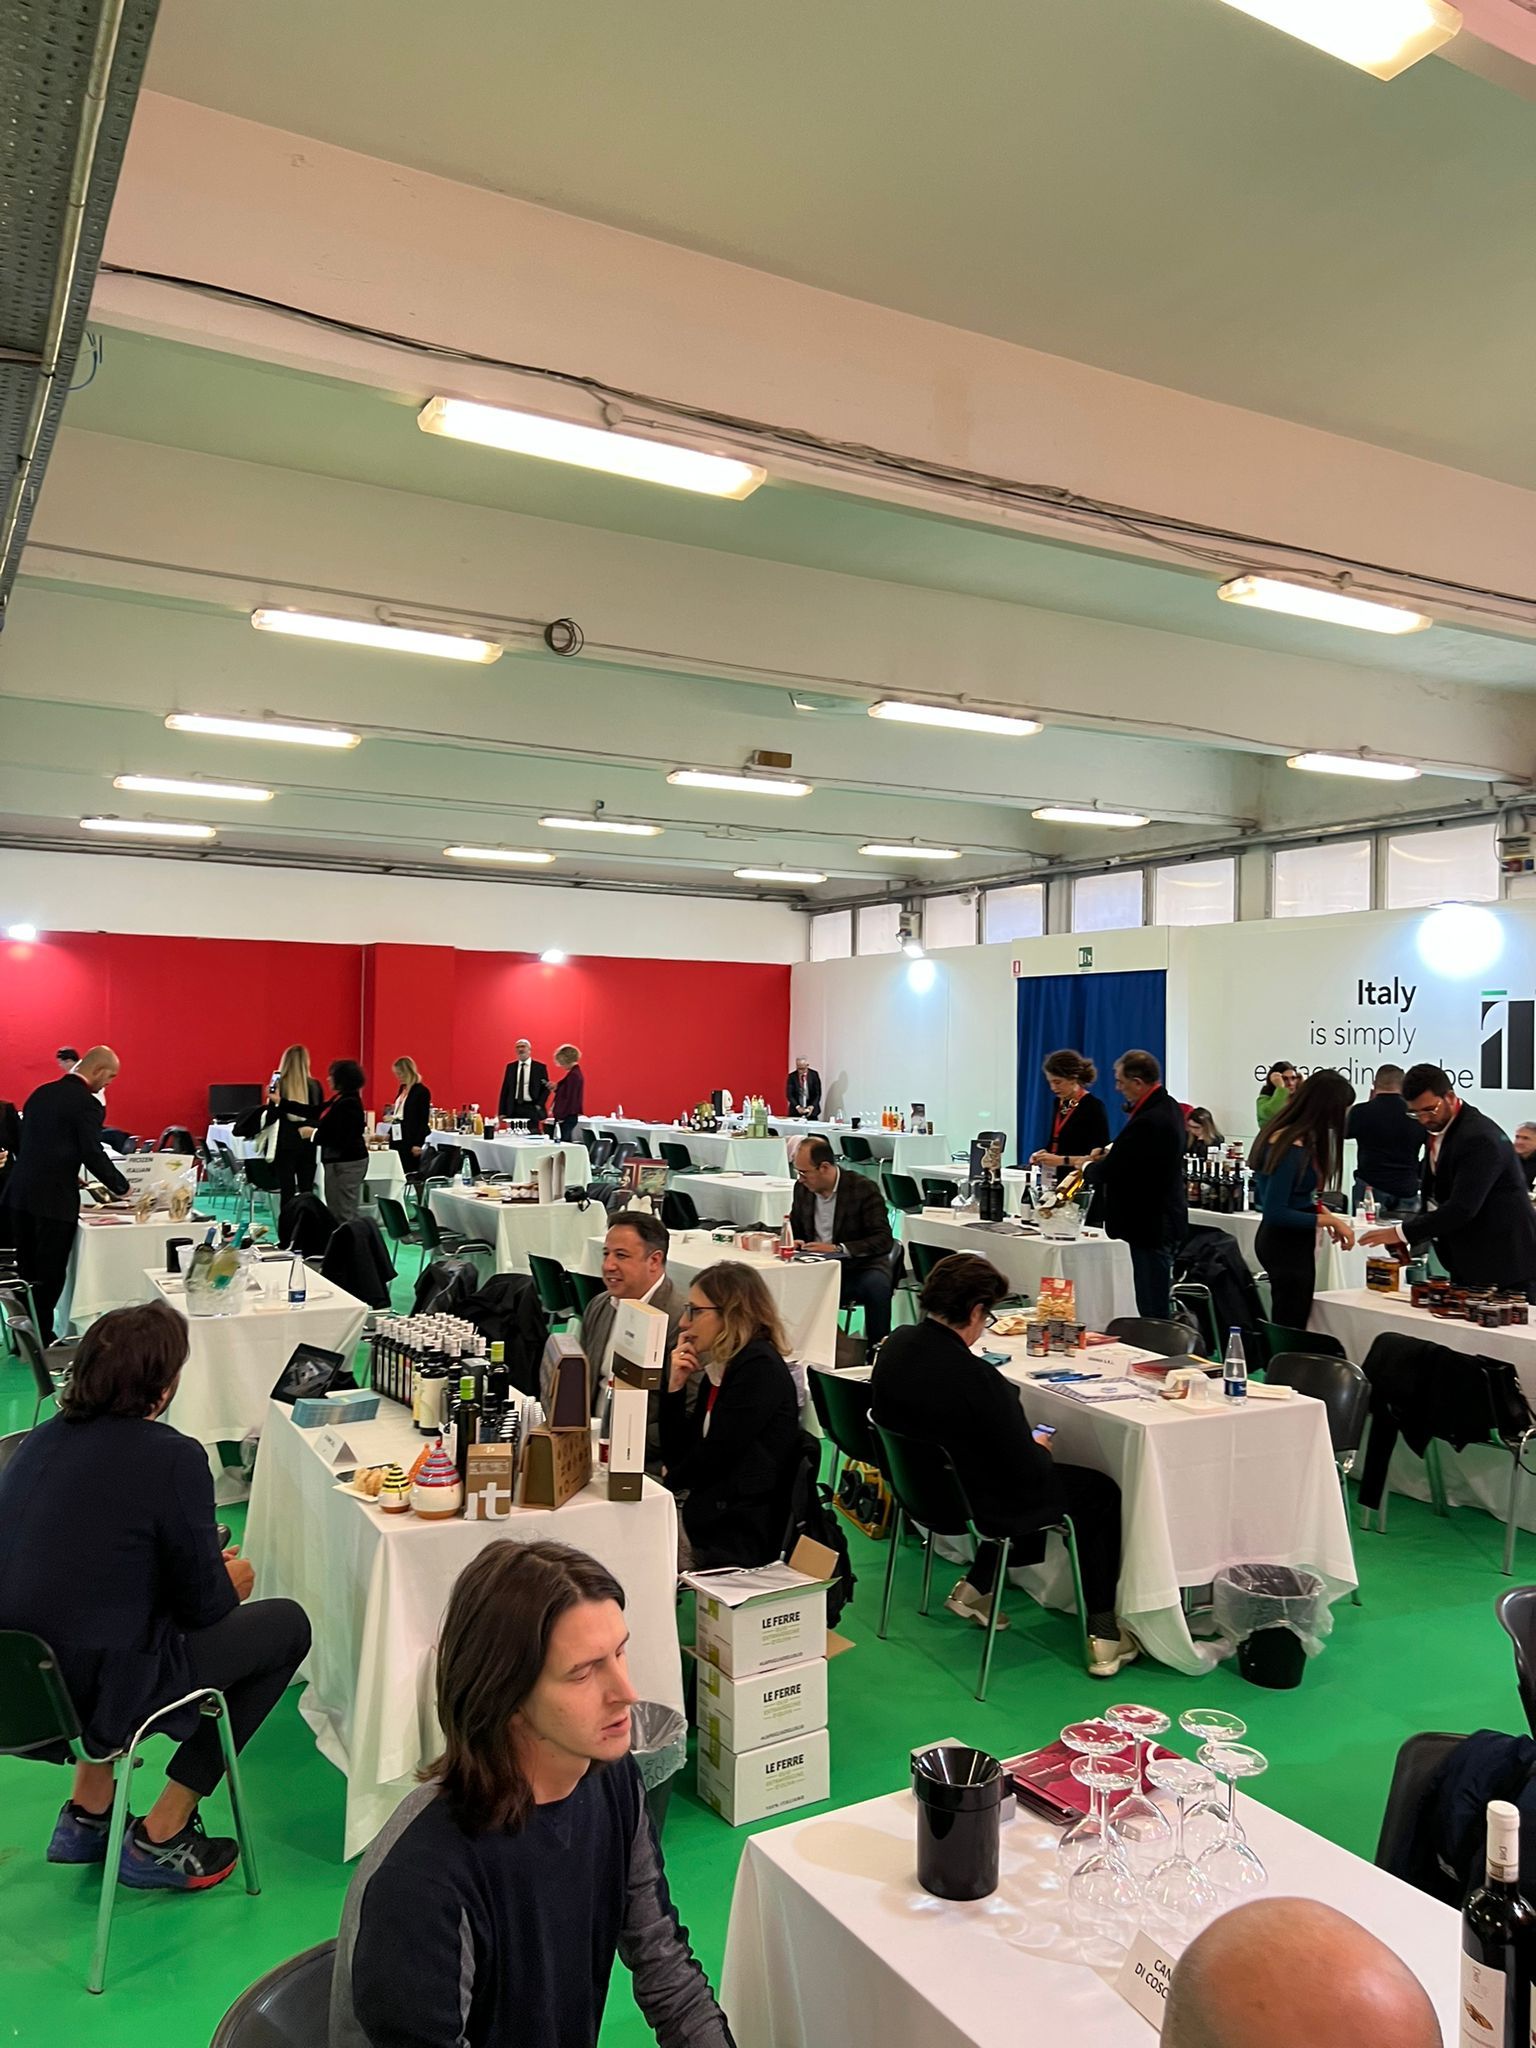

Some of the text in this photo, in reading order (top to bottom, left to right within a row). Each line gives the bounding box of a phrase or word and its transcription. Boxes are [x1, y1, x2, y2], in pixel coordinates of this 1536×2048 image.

[1357, 976, 1417, 1012] Italy
[1310, 1017, 1417, 1054] is simply
[762, 1611, 800, 1629] LE FERRE
[763, 1684, 801, 1703] LE FERRE
[765, 1754, 804, 1774] LE FERRE
[1134, 1962, 1147, 1978] DI
[1154, 1959, 1171, 1981] CAN
